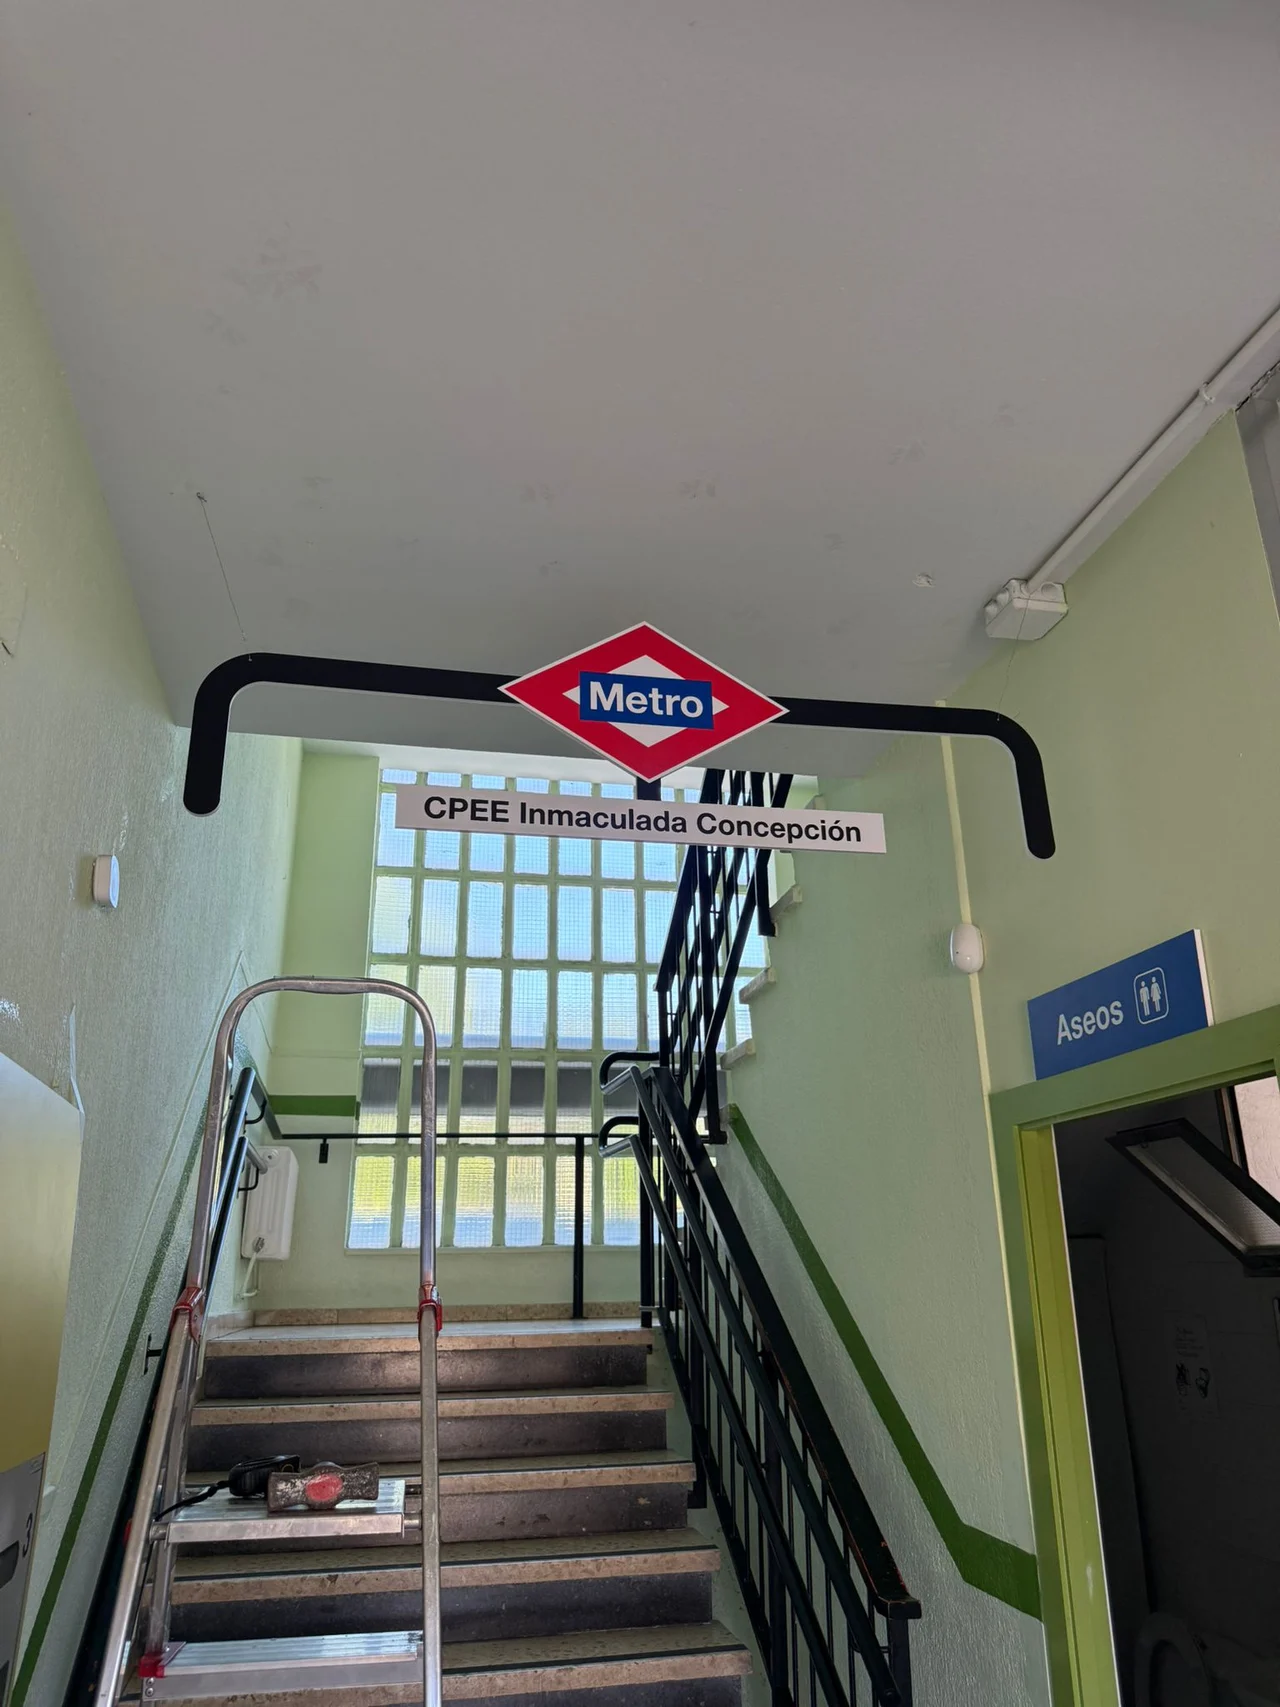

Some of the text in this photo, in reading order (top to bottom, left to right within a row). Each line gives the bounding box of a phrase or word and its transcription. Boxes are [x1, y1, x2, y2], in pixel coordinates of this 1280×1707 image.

[589, 681, 704, 718] Metro
[424, 796, 861, 844] CPEE Inmaculada Concepción
[1057, 1000, 1124, 1045] Aseos
